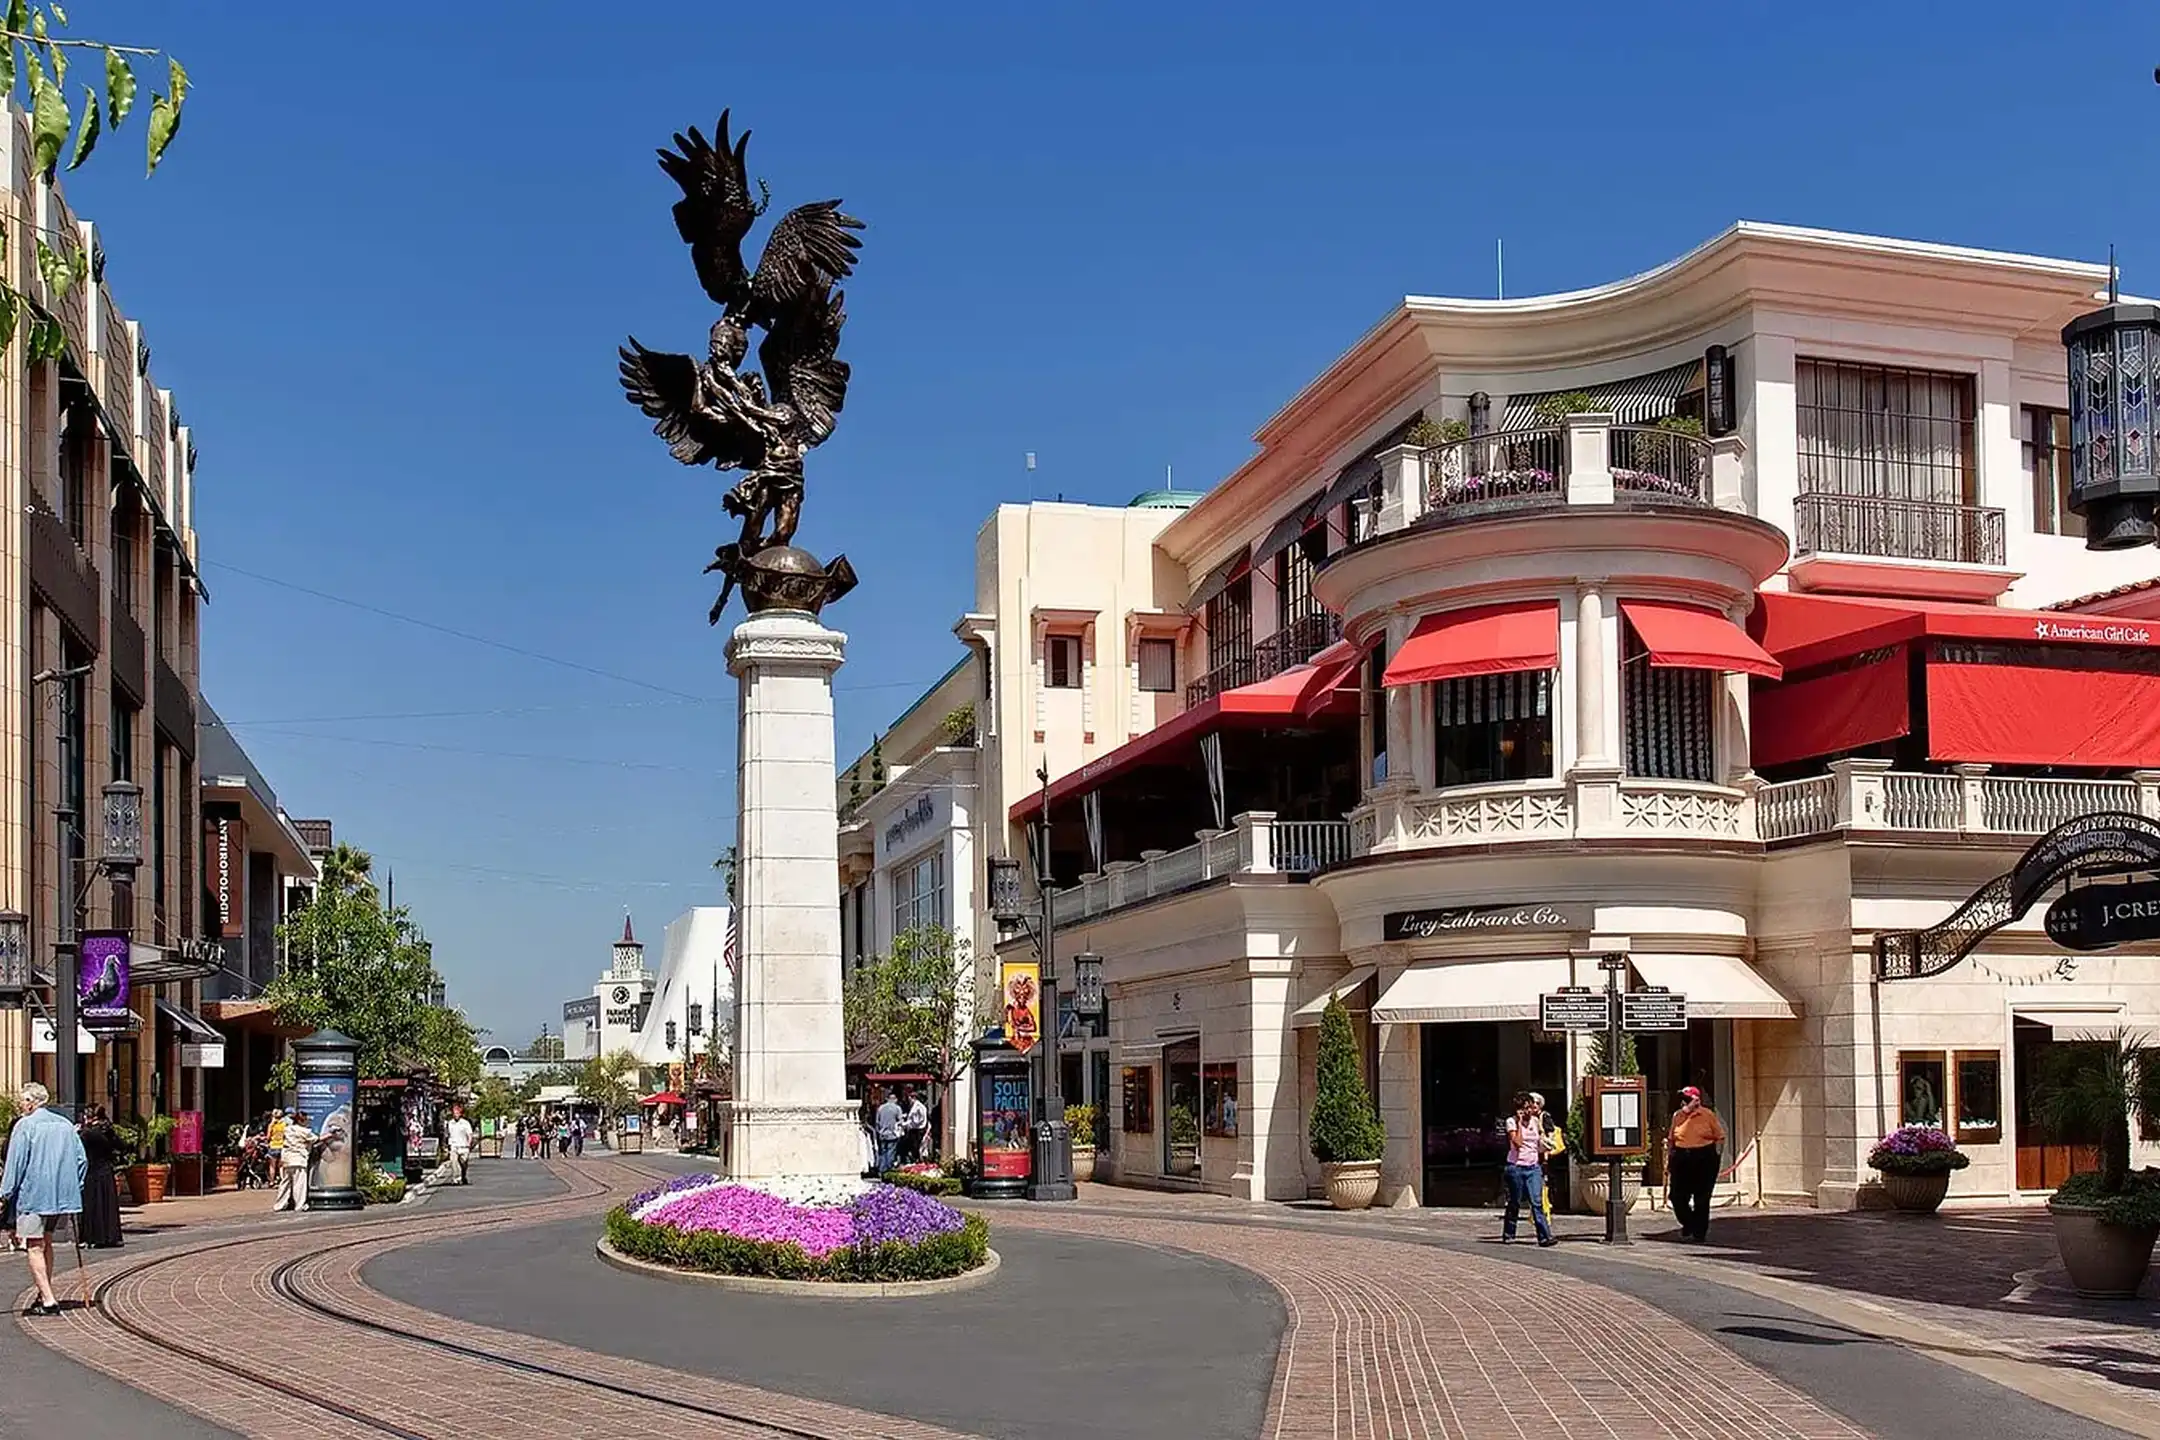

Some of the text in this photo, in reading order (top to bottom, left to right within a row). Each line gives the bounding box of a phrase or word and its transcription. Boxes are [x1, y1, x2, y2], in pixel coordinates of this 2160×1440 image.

[2051, 624, 2104, 640] American
[2104, 626, 2124, 641] Girl
[219, 816, 229, 924] ANTHROPOLOGIE
[1400, 906, 1567, 937] Lucy Zahran & Co.
[2102, 901, 2160, 928] J.CRE
[606, 1008, 632, 1017] FARMER
[608, 1016, 631, 1025] MARKE
